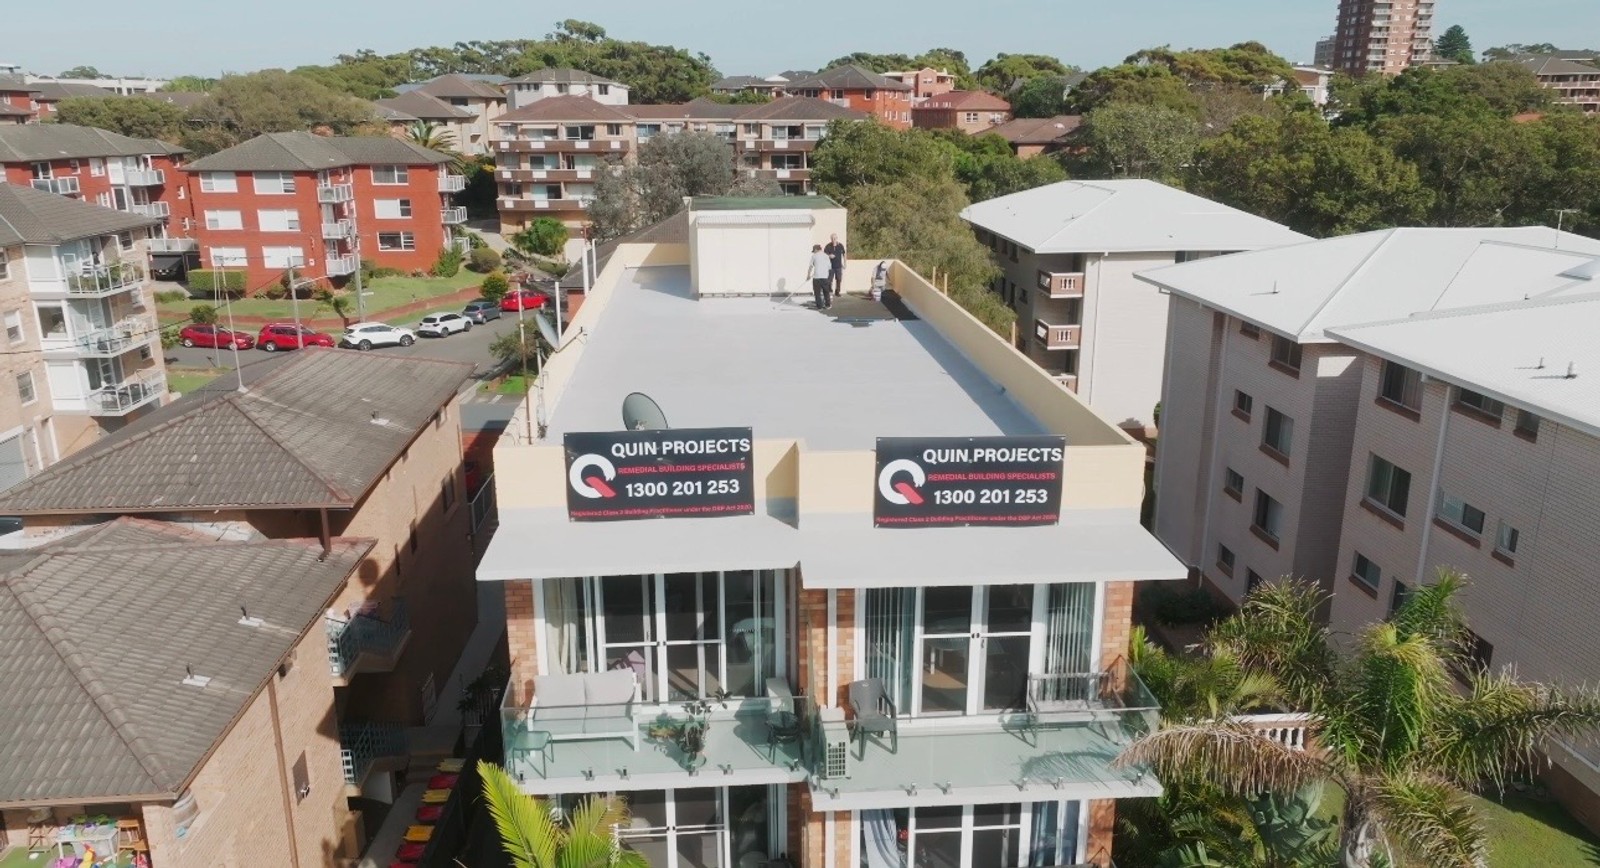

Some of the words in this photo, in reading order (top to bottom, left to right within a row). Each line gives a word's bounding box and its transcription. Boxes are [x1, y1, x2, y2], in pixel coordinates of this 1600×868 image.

[611, 442, 657, 458] QUIN
[662, 438, 751, 455] PROJECTS
[922, 448, 969, 465] QUIN
[973, 447, 1062, 463] PROJECTS
[617, 466, 658, 474] REMEDIAL
[659, 465, 696, 473] BUILDING
[697, 462, 746, 472] SPECIALISTS
[927, 473, 967, 481] REMEDIAL
[968, 472, 1006, 480] BUILDING
[1007, 472, 1056, 480] SPECIALISTS
[625, 481, 668, 498] 1300
[672, 480, 702, 496] 201
[707, 478, 740, 494] 253
[934, 489, 975, 505] 1300
[980, 488, 1010, 504] 201
[1014, 488, 1048, 504] 253
